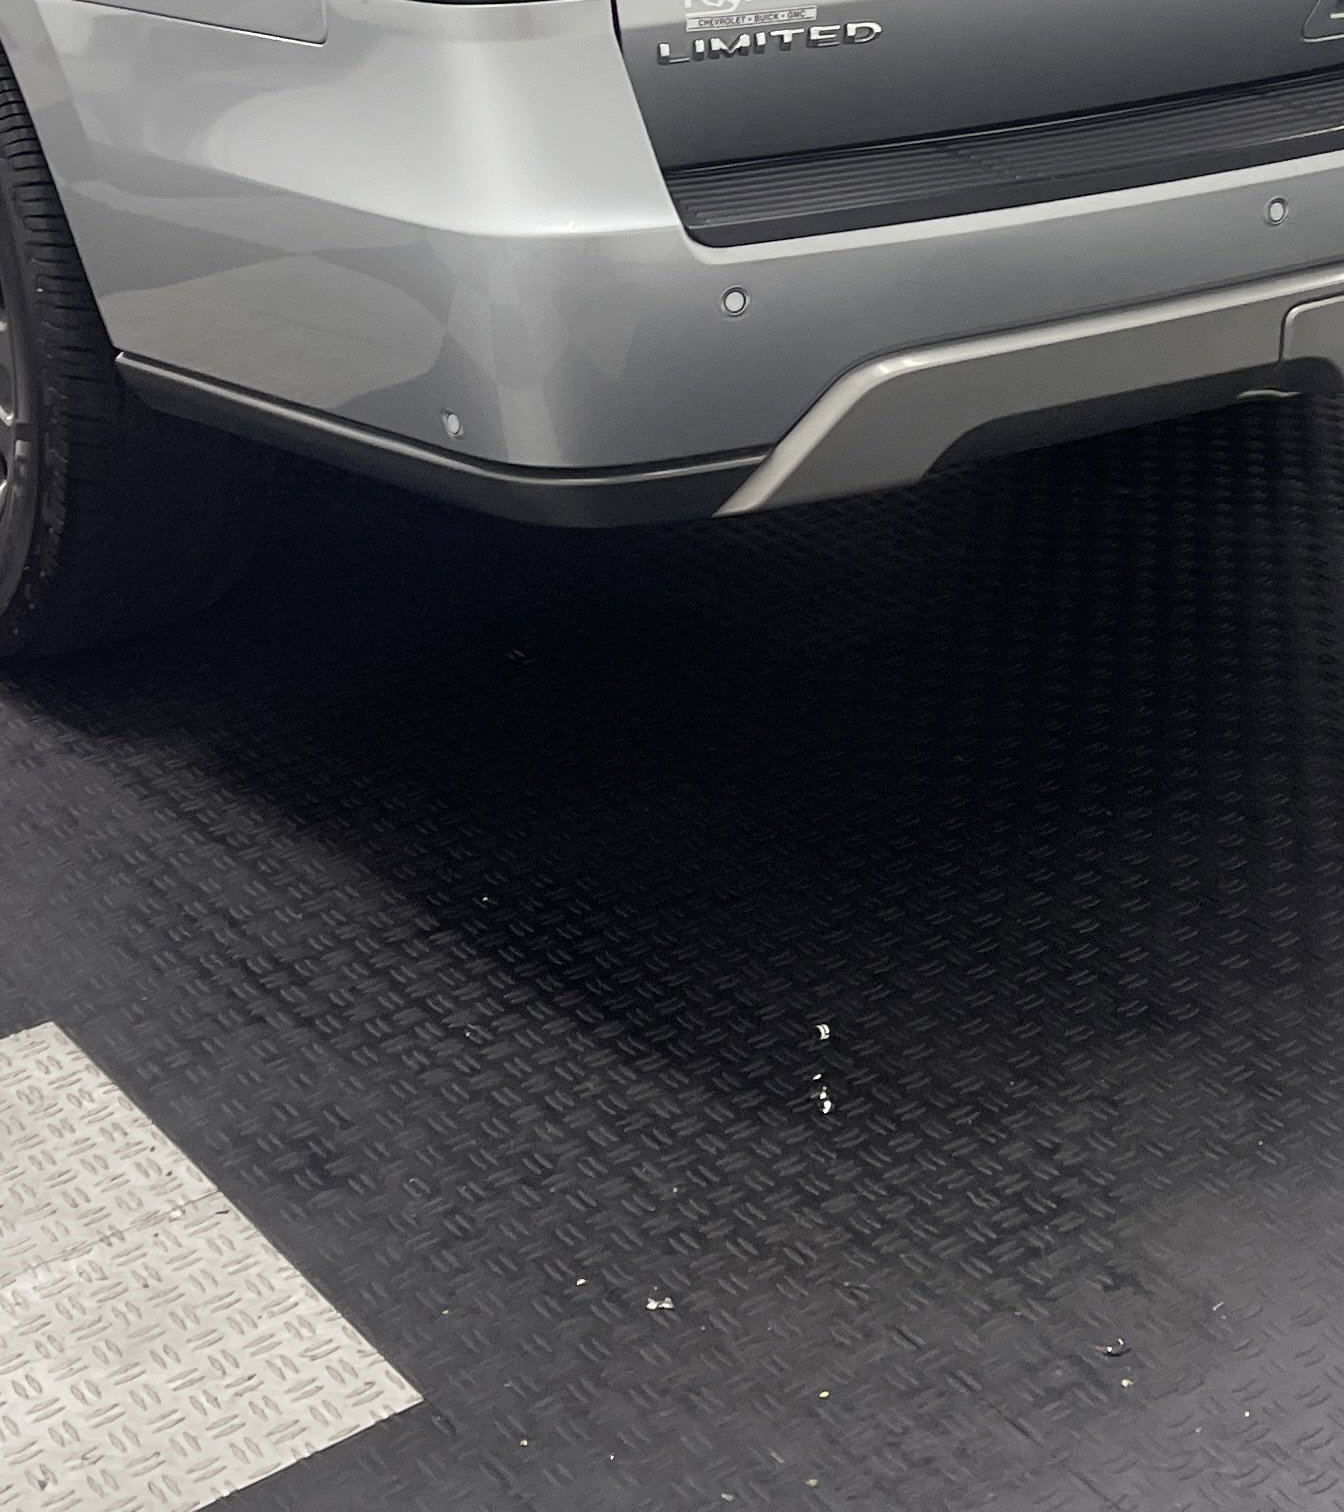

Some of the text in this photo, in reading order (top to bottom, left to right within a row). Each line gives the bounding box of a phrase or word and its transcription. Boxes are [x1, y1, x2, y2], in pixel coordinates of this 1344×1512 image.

[754, 12, 779, 24] BUICK
[786, 8, 807, 19] GMC
[656, 21, 883, 66] LIMITED
